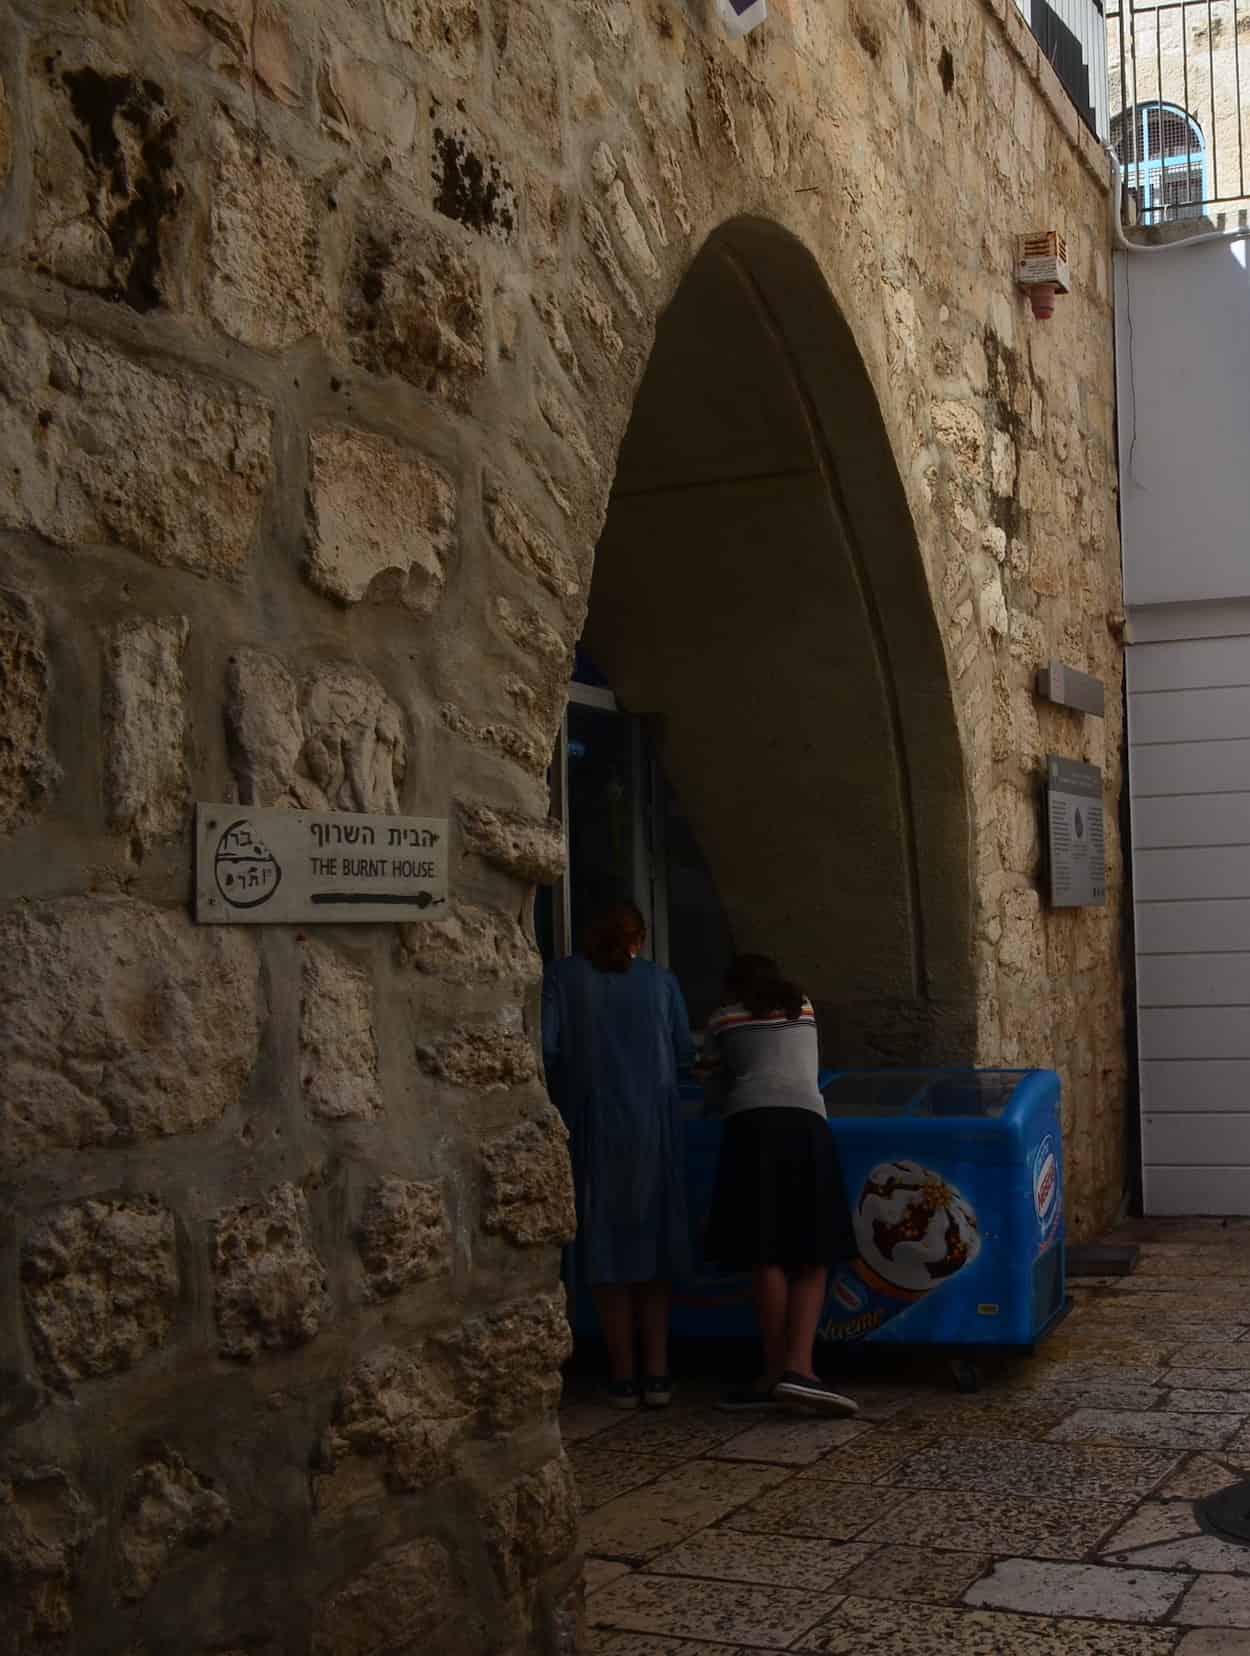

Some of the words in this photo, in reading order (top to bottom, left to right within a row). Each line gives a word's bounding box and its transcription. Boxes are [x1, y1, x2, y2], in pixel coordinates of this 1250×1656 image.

[311, 824, 374, 847] השרוף
[388, 827, 435, 847] הבית
[310, 858, 337, 877] THE
[343, 859, 388, 878] BURNT
[392, 860, 436, 879] HOUSE
